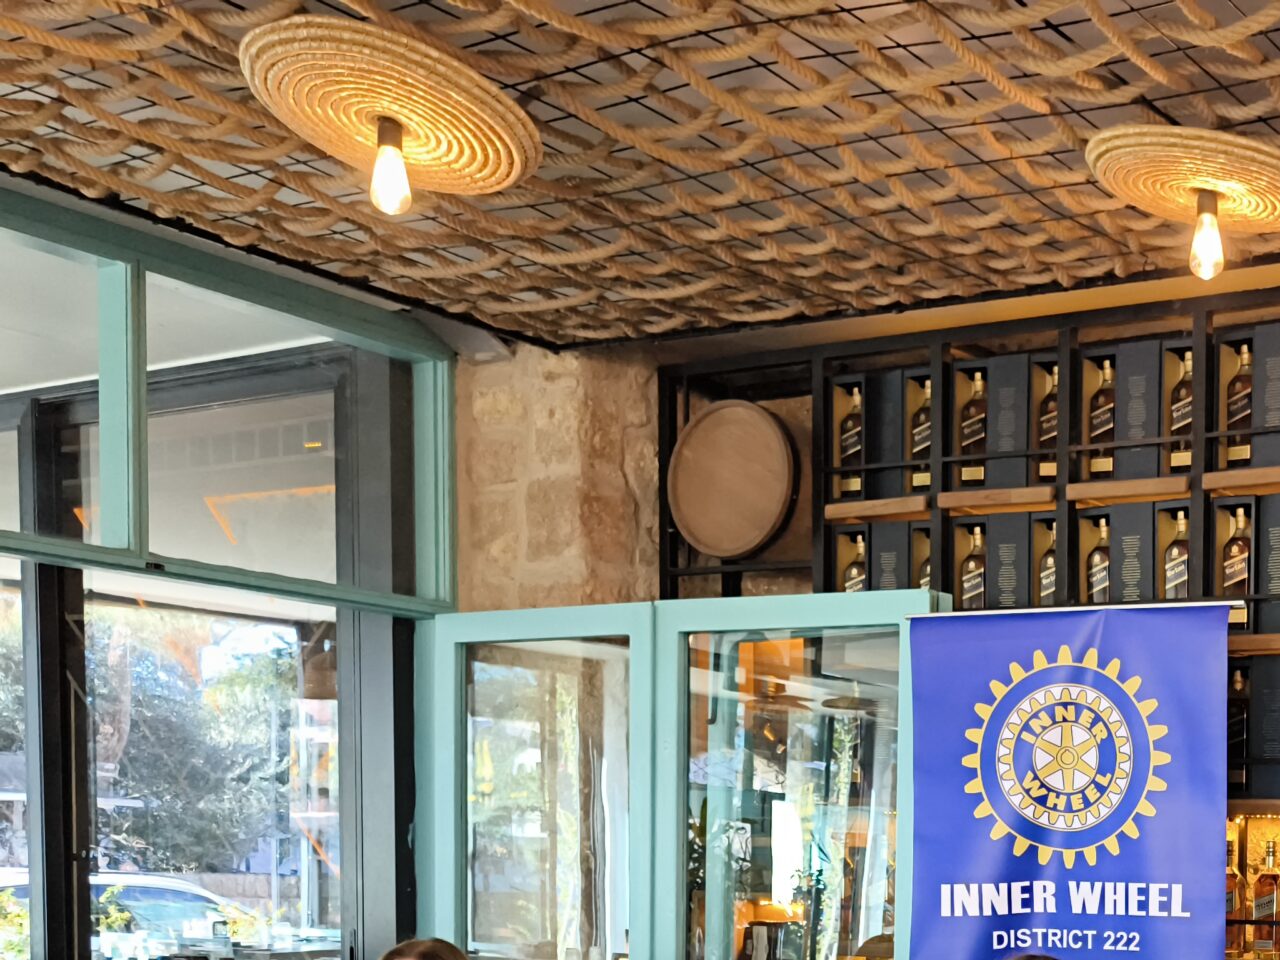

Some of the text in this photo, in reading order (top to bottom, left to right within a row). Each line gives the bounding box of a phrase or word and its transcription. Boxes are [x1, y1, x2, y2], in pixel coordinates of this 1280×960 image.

[1020, 704, 1109, 745] INNER
[1021, 770, 1112, 811] WHEEL
[940, 880, 1191, 918] INNER WHEEL
[992, 928, 1140, 952] DISTRICT 222
